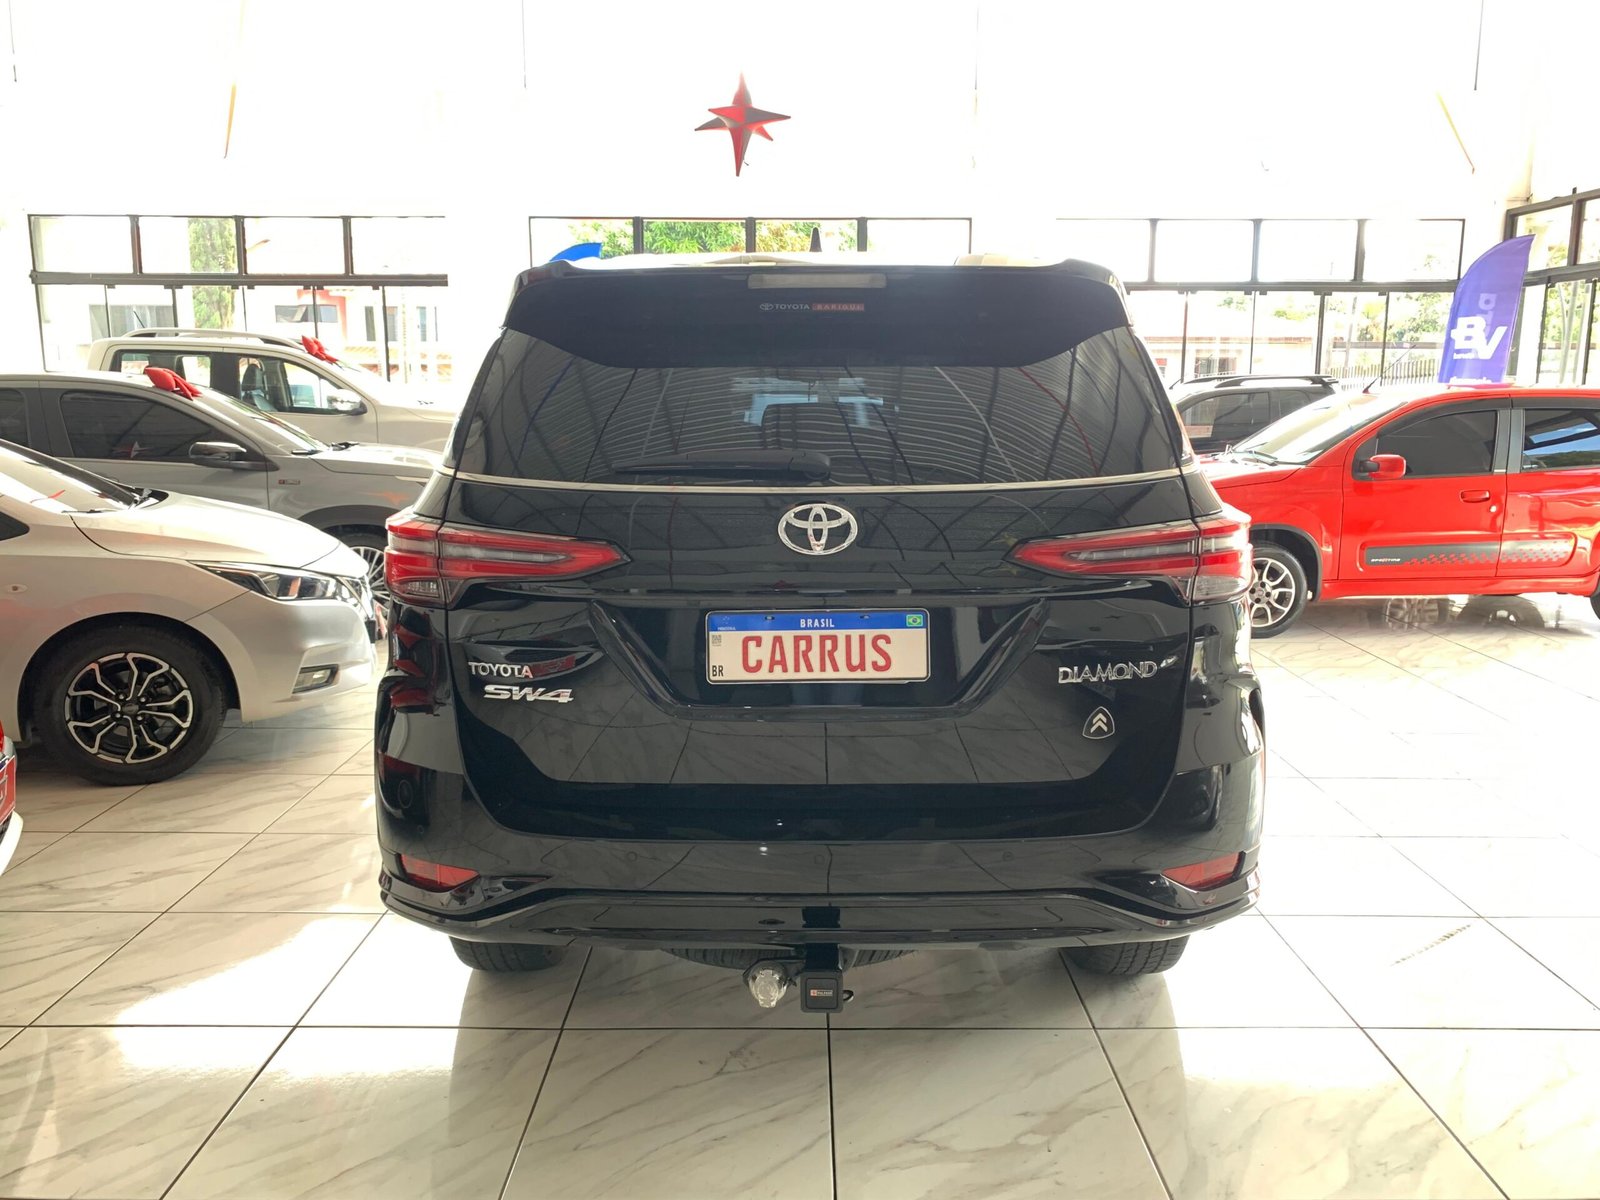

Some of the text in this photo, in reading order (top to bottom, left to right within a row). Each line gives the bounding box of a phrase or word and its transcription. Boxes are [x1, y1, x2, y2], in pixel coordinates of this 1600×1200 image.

[800, 618, 835, 628] BRASIL
[742, 634, 892, 673] CARRUS
[468, 661, 533, 678] TOYOTA
[711, 665, 724, 677] BR
[1058, 661, 1158, 683] DIAMOND
[483, 684, 574, 703] SW4
